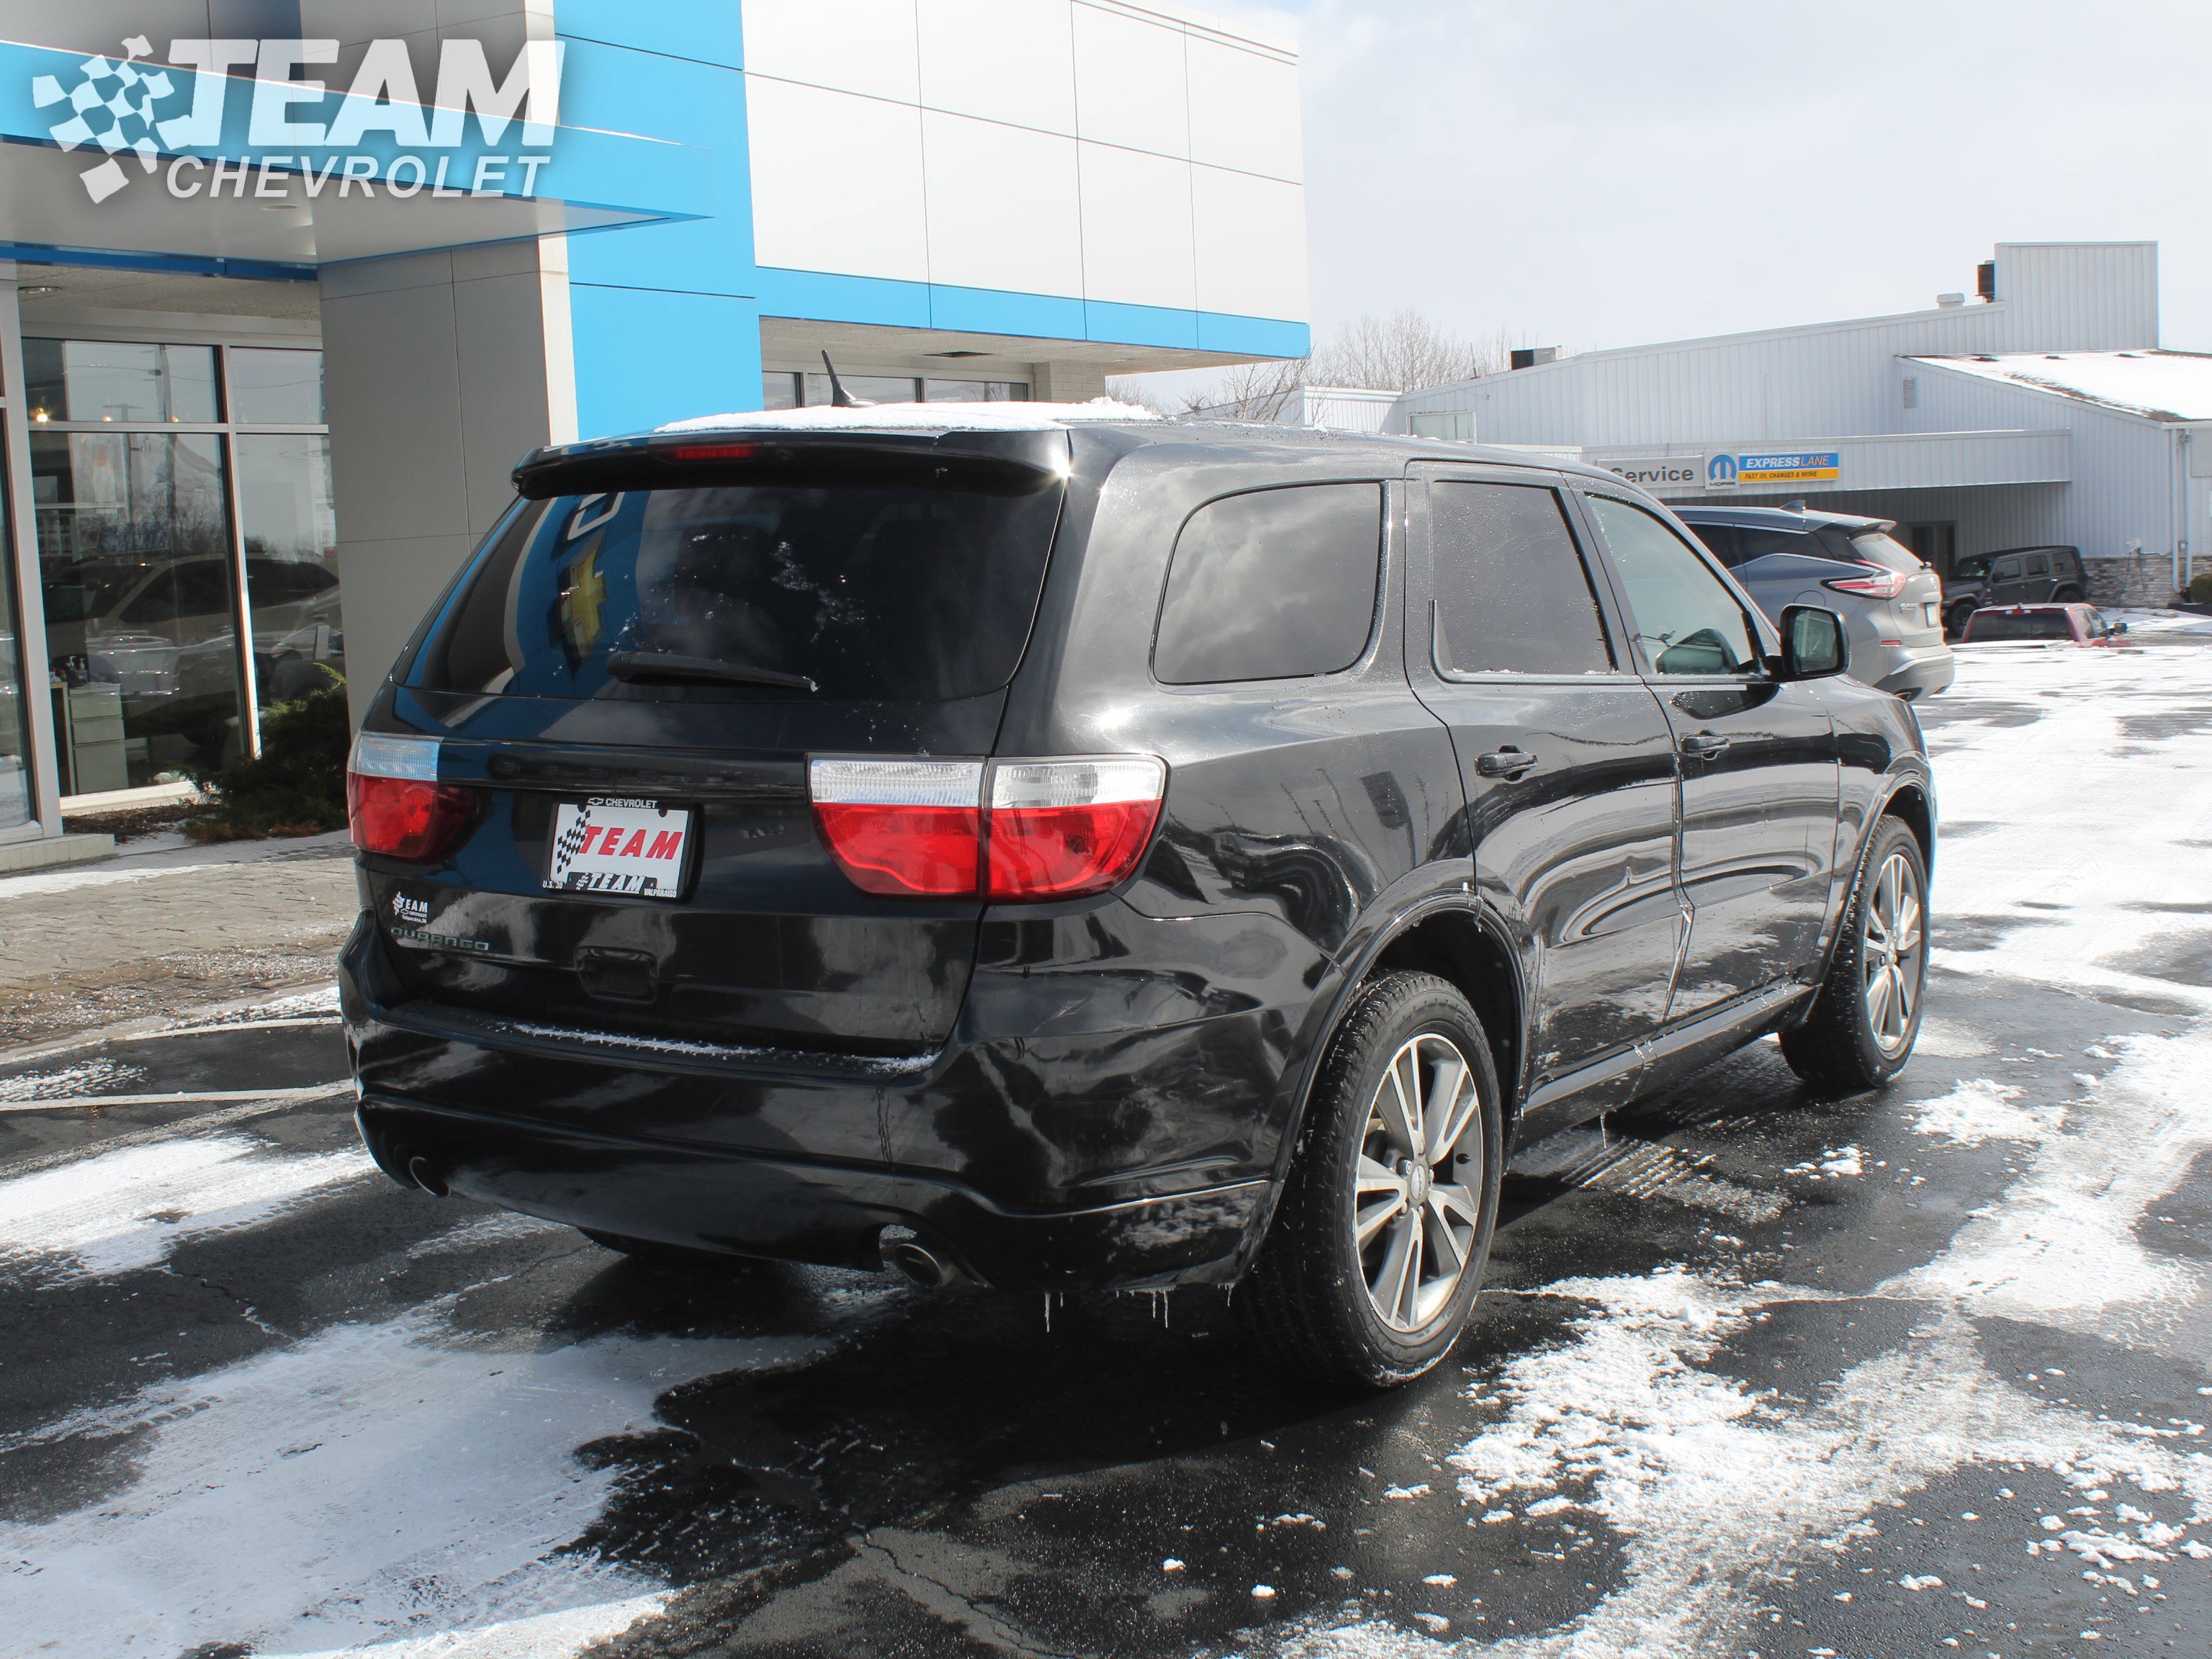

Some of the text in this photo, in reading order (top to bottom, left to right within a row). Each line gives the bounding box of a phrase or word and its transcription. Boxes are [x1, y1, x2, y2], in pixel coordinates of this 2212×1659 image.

[605, 798, 657, 809] CHEVROLET
[579, 826, 683, 860] TEAM
[542, 880, 563, 889] U.S. 30
[588, 873, 645, 892] TEAM
[644, 888, 678, 898] VALPARAISO
[400, 897, 428, 913] TEAM
[391, 927, 490, 950] DURANGO
